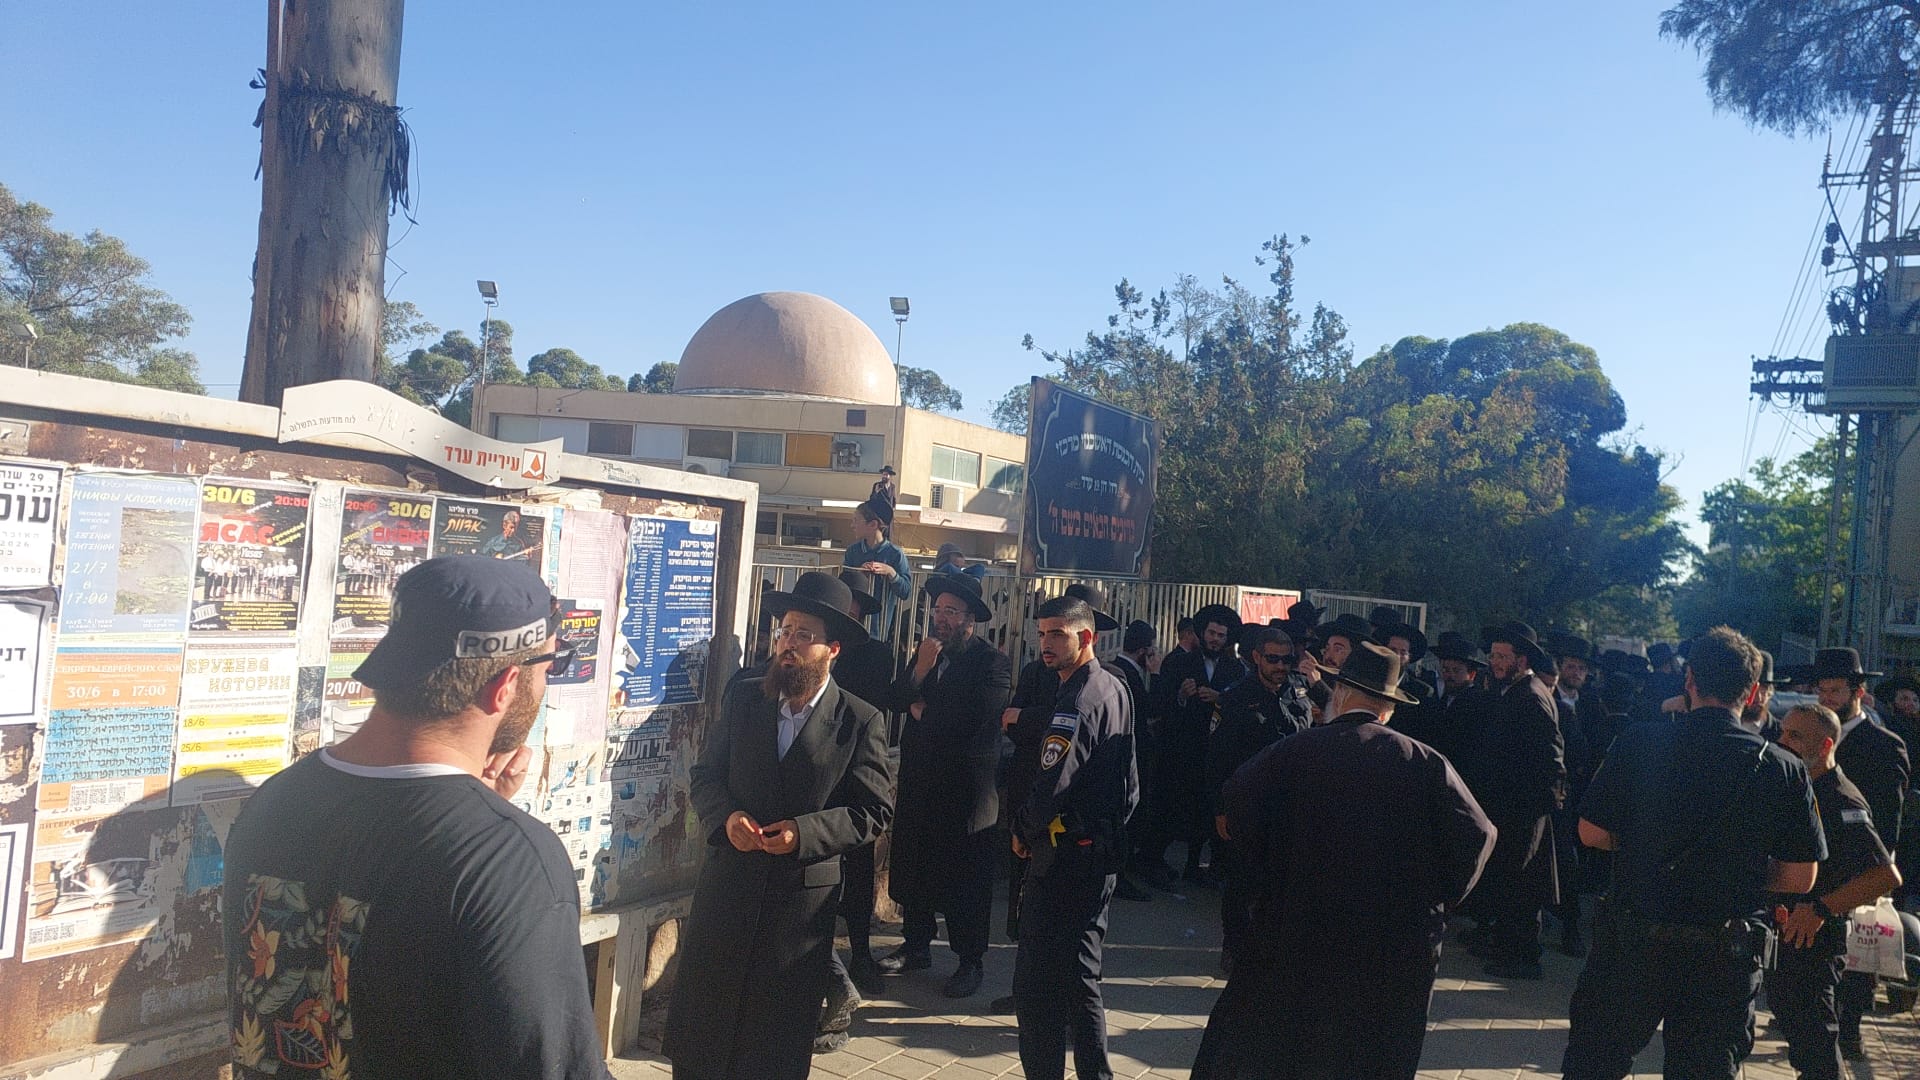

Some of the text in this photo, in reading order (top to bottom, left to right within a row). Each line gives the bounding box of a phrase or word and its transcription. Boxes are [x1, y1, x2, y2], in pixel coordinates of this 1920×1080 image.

[444, 445, 520, 472] עיריית ערד
[29, 472, 44, 481] 29
[72, 490, 120, 500] НИМФЫ
[203, 486, 256, 505] 30/6
[274, 495, 309, 508] 20:00
[388, 501, 432, 519] 30/6
[200, 522, 275, 547] ЯСАС
[70, 561, 107, 575] 21/7
[66, 592, 108, 605] 17:00
[463, 623, 545, 654] POLICE
[185, 657, 270, 674] КРУЖЕВА
[67, 686, 101, 699] 30/6
[132, 685, 166, 697] 17:00
[208, 675, 292, 693] ИСТОРИИ
[326, 681, 362, 697] 20/07
[183, 718, 205, 728] 18/6
[180, 742, 202, 752] 25/6
